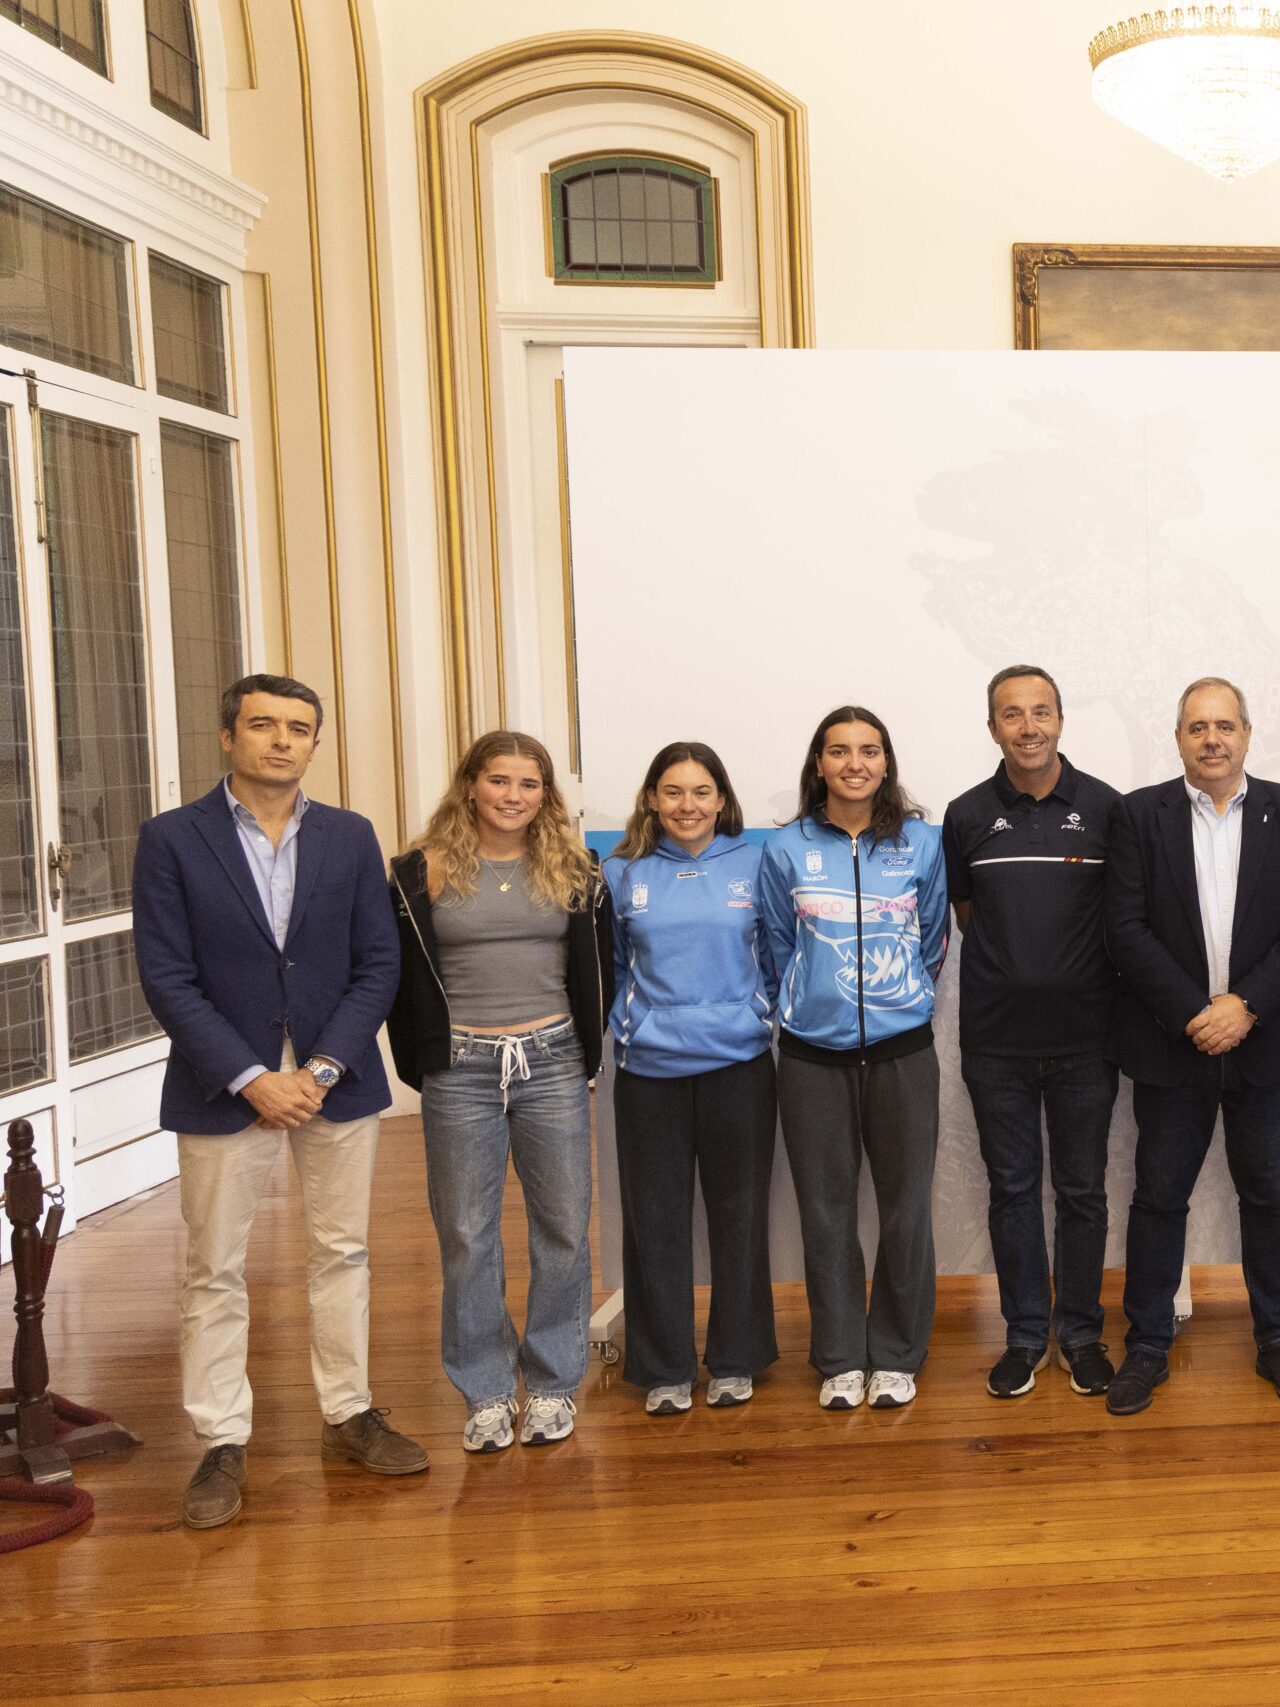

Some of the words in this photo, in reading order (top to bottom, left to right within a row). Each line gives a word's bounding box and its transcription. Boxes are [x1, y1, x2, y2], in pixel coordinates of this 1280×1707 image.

[886, 857, 909, 866] Ford
[802, 874, 828, 882] NARÓN
[881, 870, 916, 878] Galmotor
